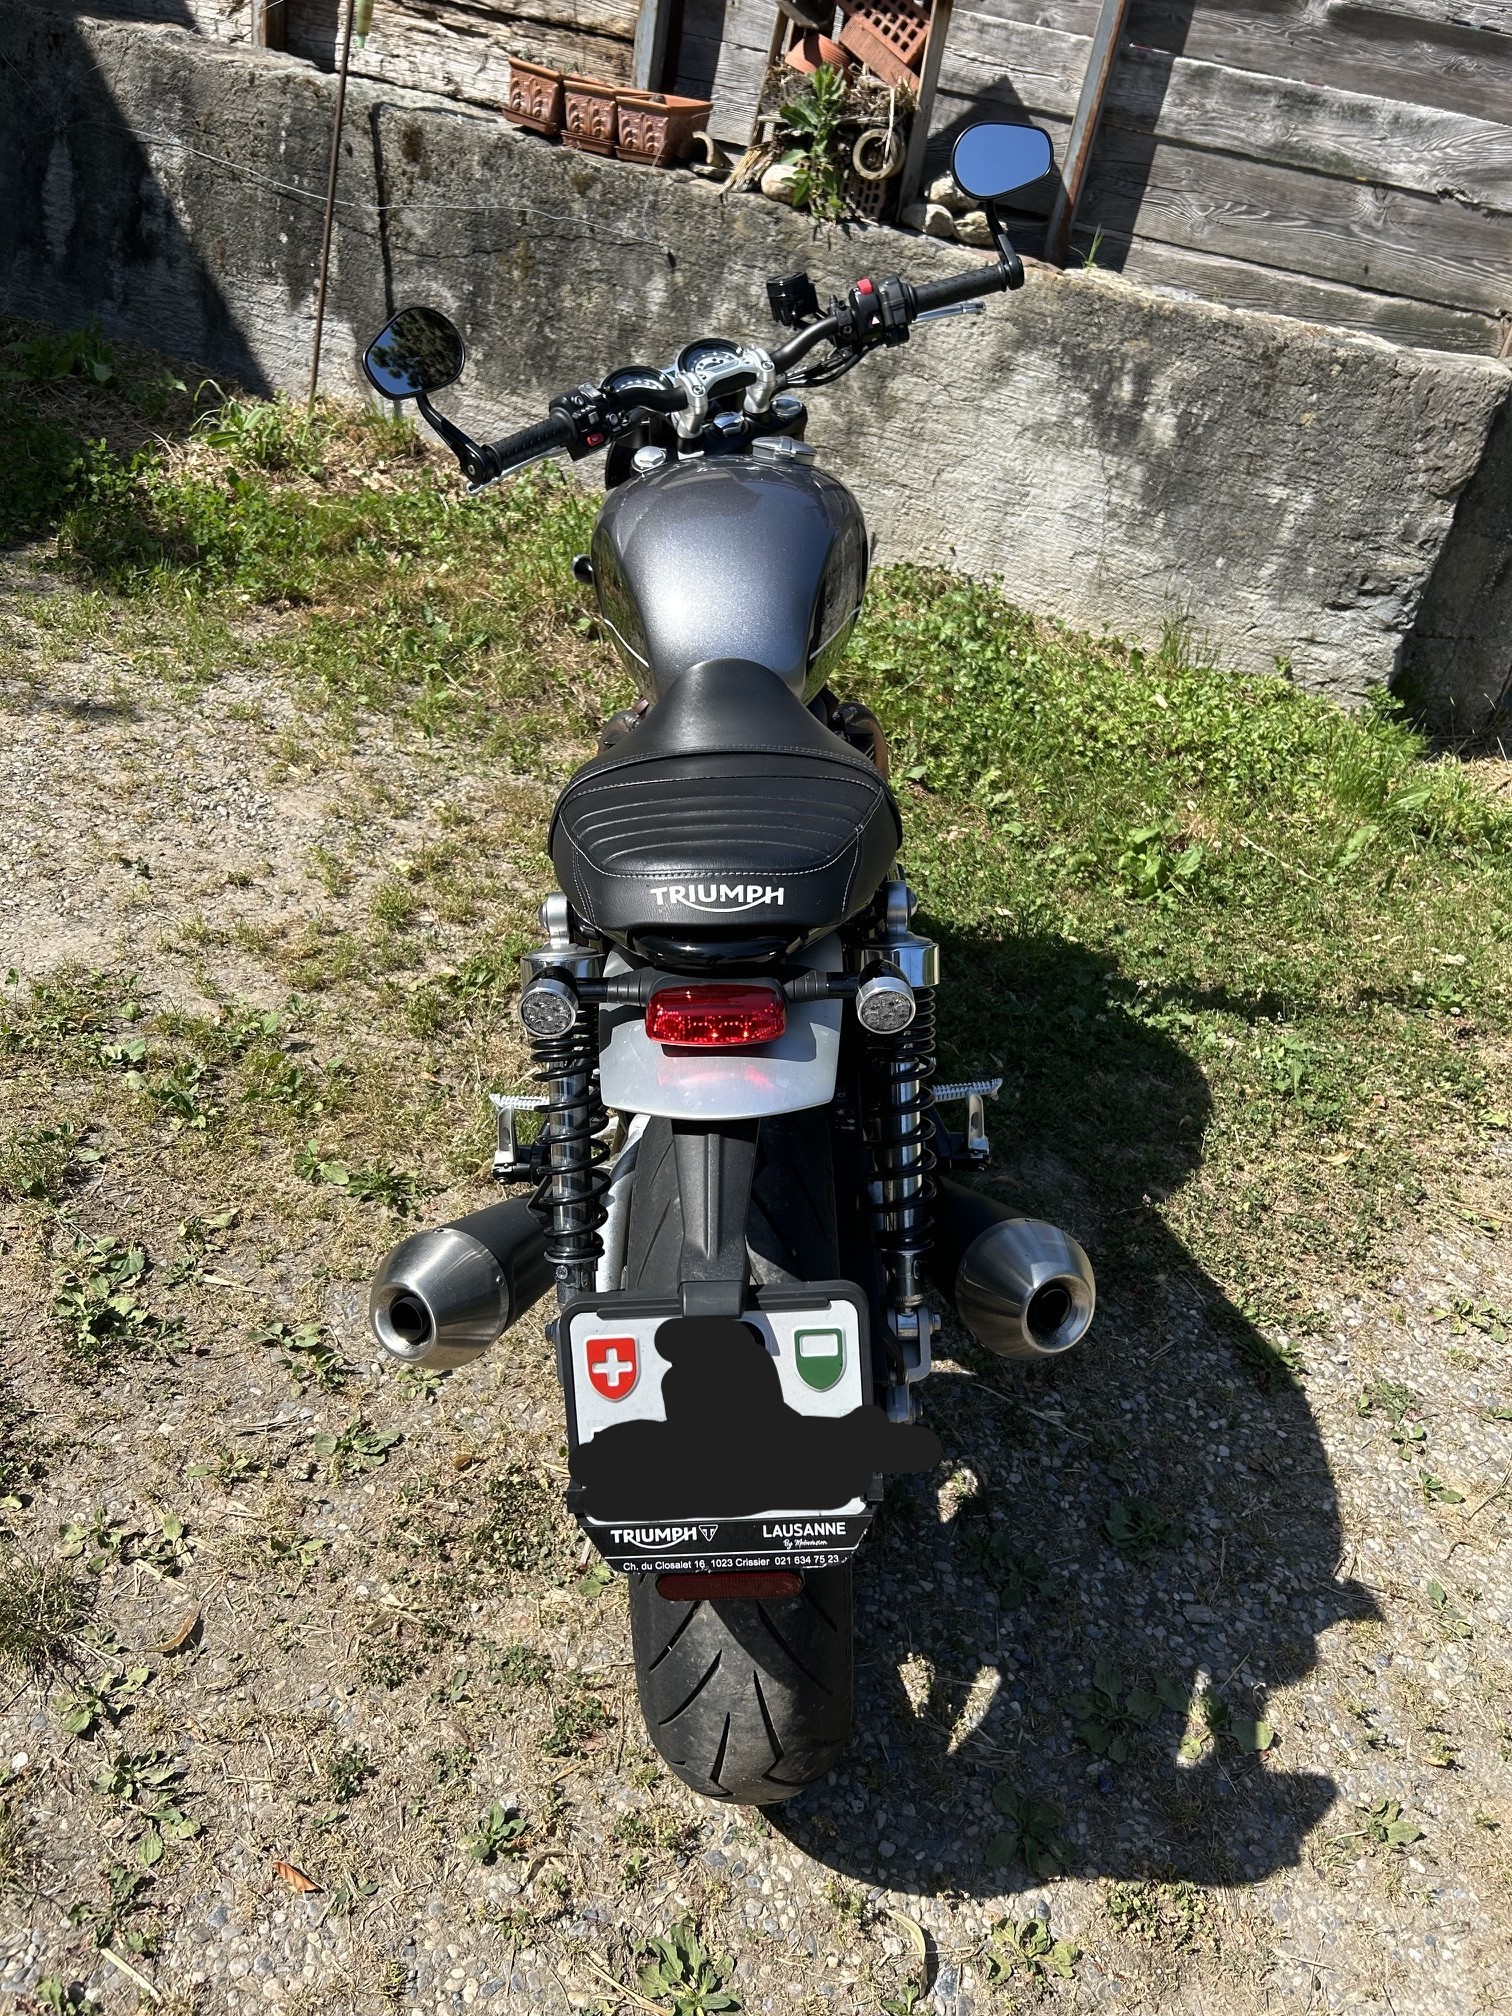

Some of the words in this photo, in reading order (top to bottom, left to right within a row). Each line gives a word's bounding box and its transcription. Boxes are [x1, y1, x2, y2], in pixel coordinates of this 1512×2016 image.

[650, 884, 785, 913] TRIUMPH
[610, 1527, 698, 1550] TRIUMPH
[762, 1522, 847, 1538] LAUSANNE
[623, 1562, 639, 1571] Ch.
[641, 1561, 653, 1570] du
[655, 1560, 692, 1570] Closalet
[711, 1558, 733, 1568] 1023
[735, 1557, 770, 1567] Crissier
[774, 1556, 791, 1566] 021
[794, 1555, 812, 1565] 634
[814, 1554, 826, 1564] 75
[827, 1554, 839, 1563] 23
